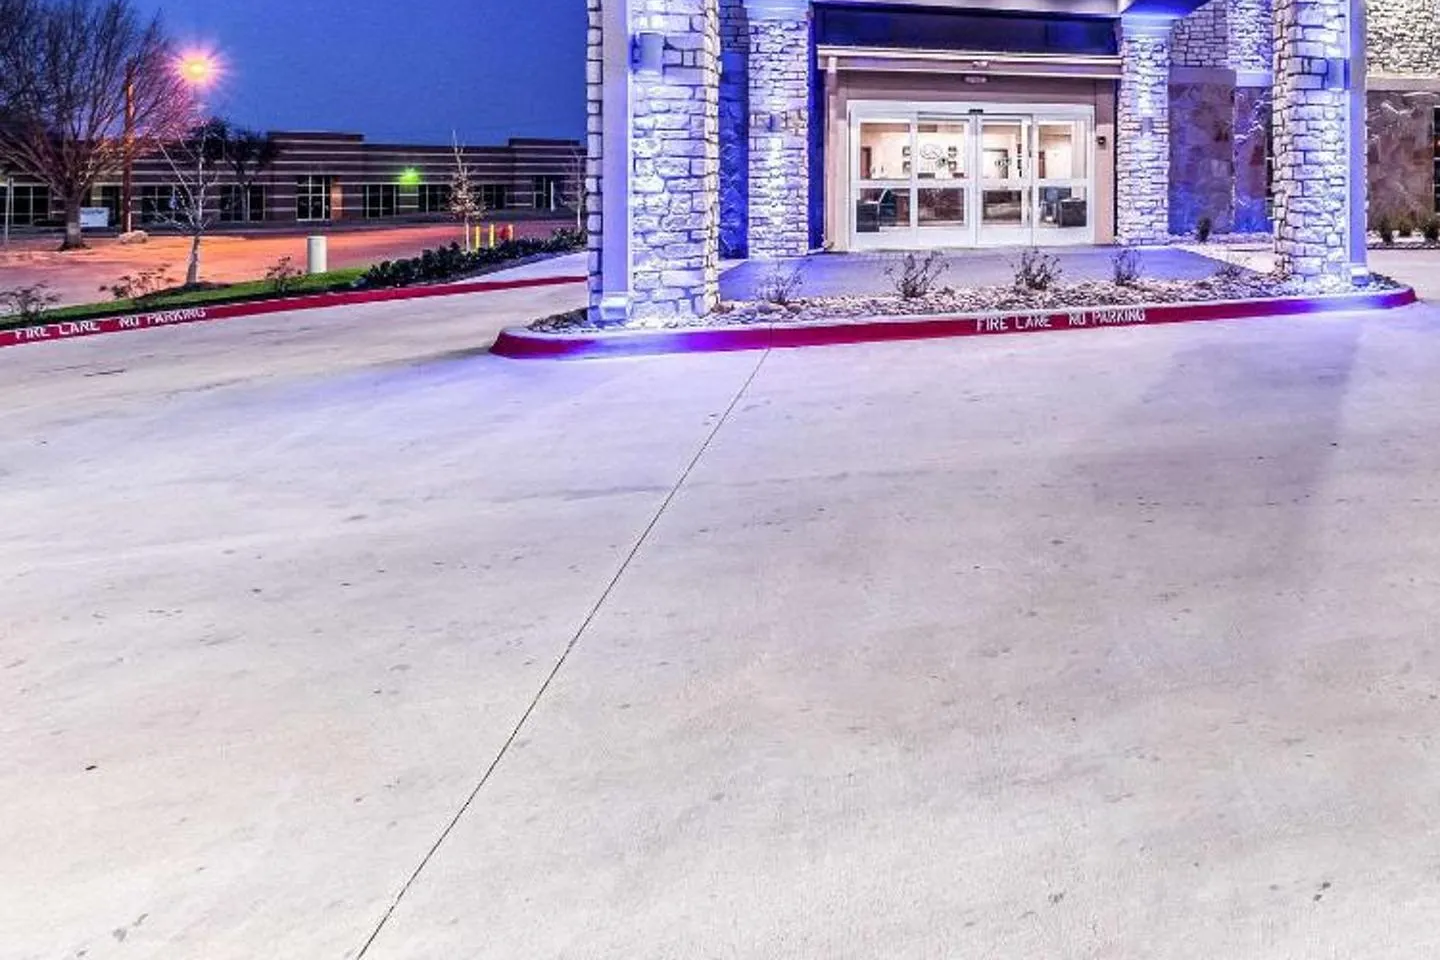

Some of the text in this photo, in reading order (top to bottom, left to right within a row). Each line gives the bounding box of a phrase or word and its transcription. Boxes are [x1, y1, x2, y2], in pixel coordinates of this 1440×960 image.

[147, 307, 207, 324] PARKING
[976, 318, 1008, 332] FIRE
[1015, 314, 1052, 330] LANE
[1092, 308, 1146, 325] PARKING
